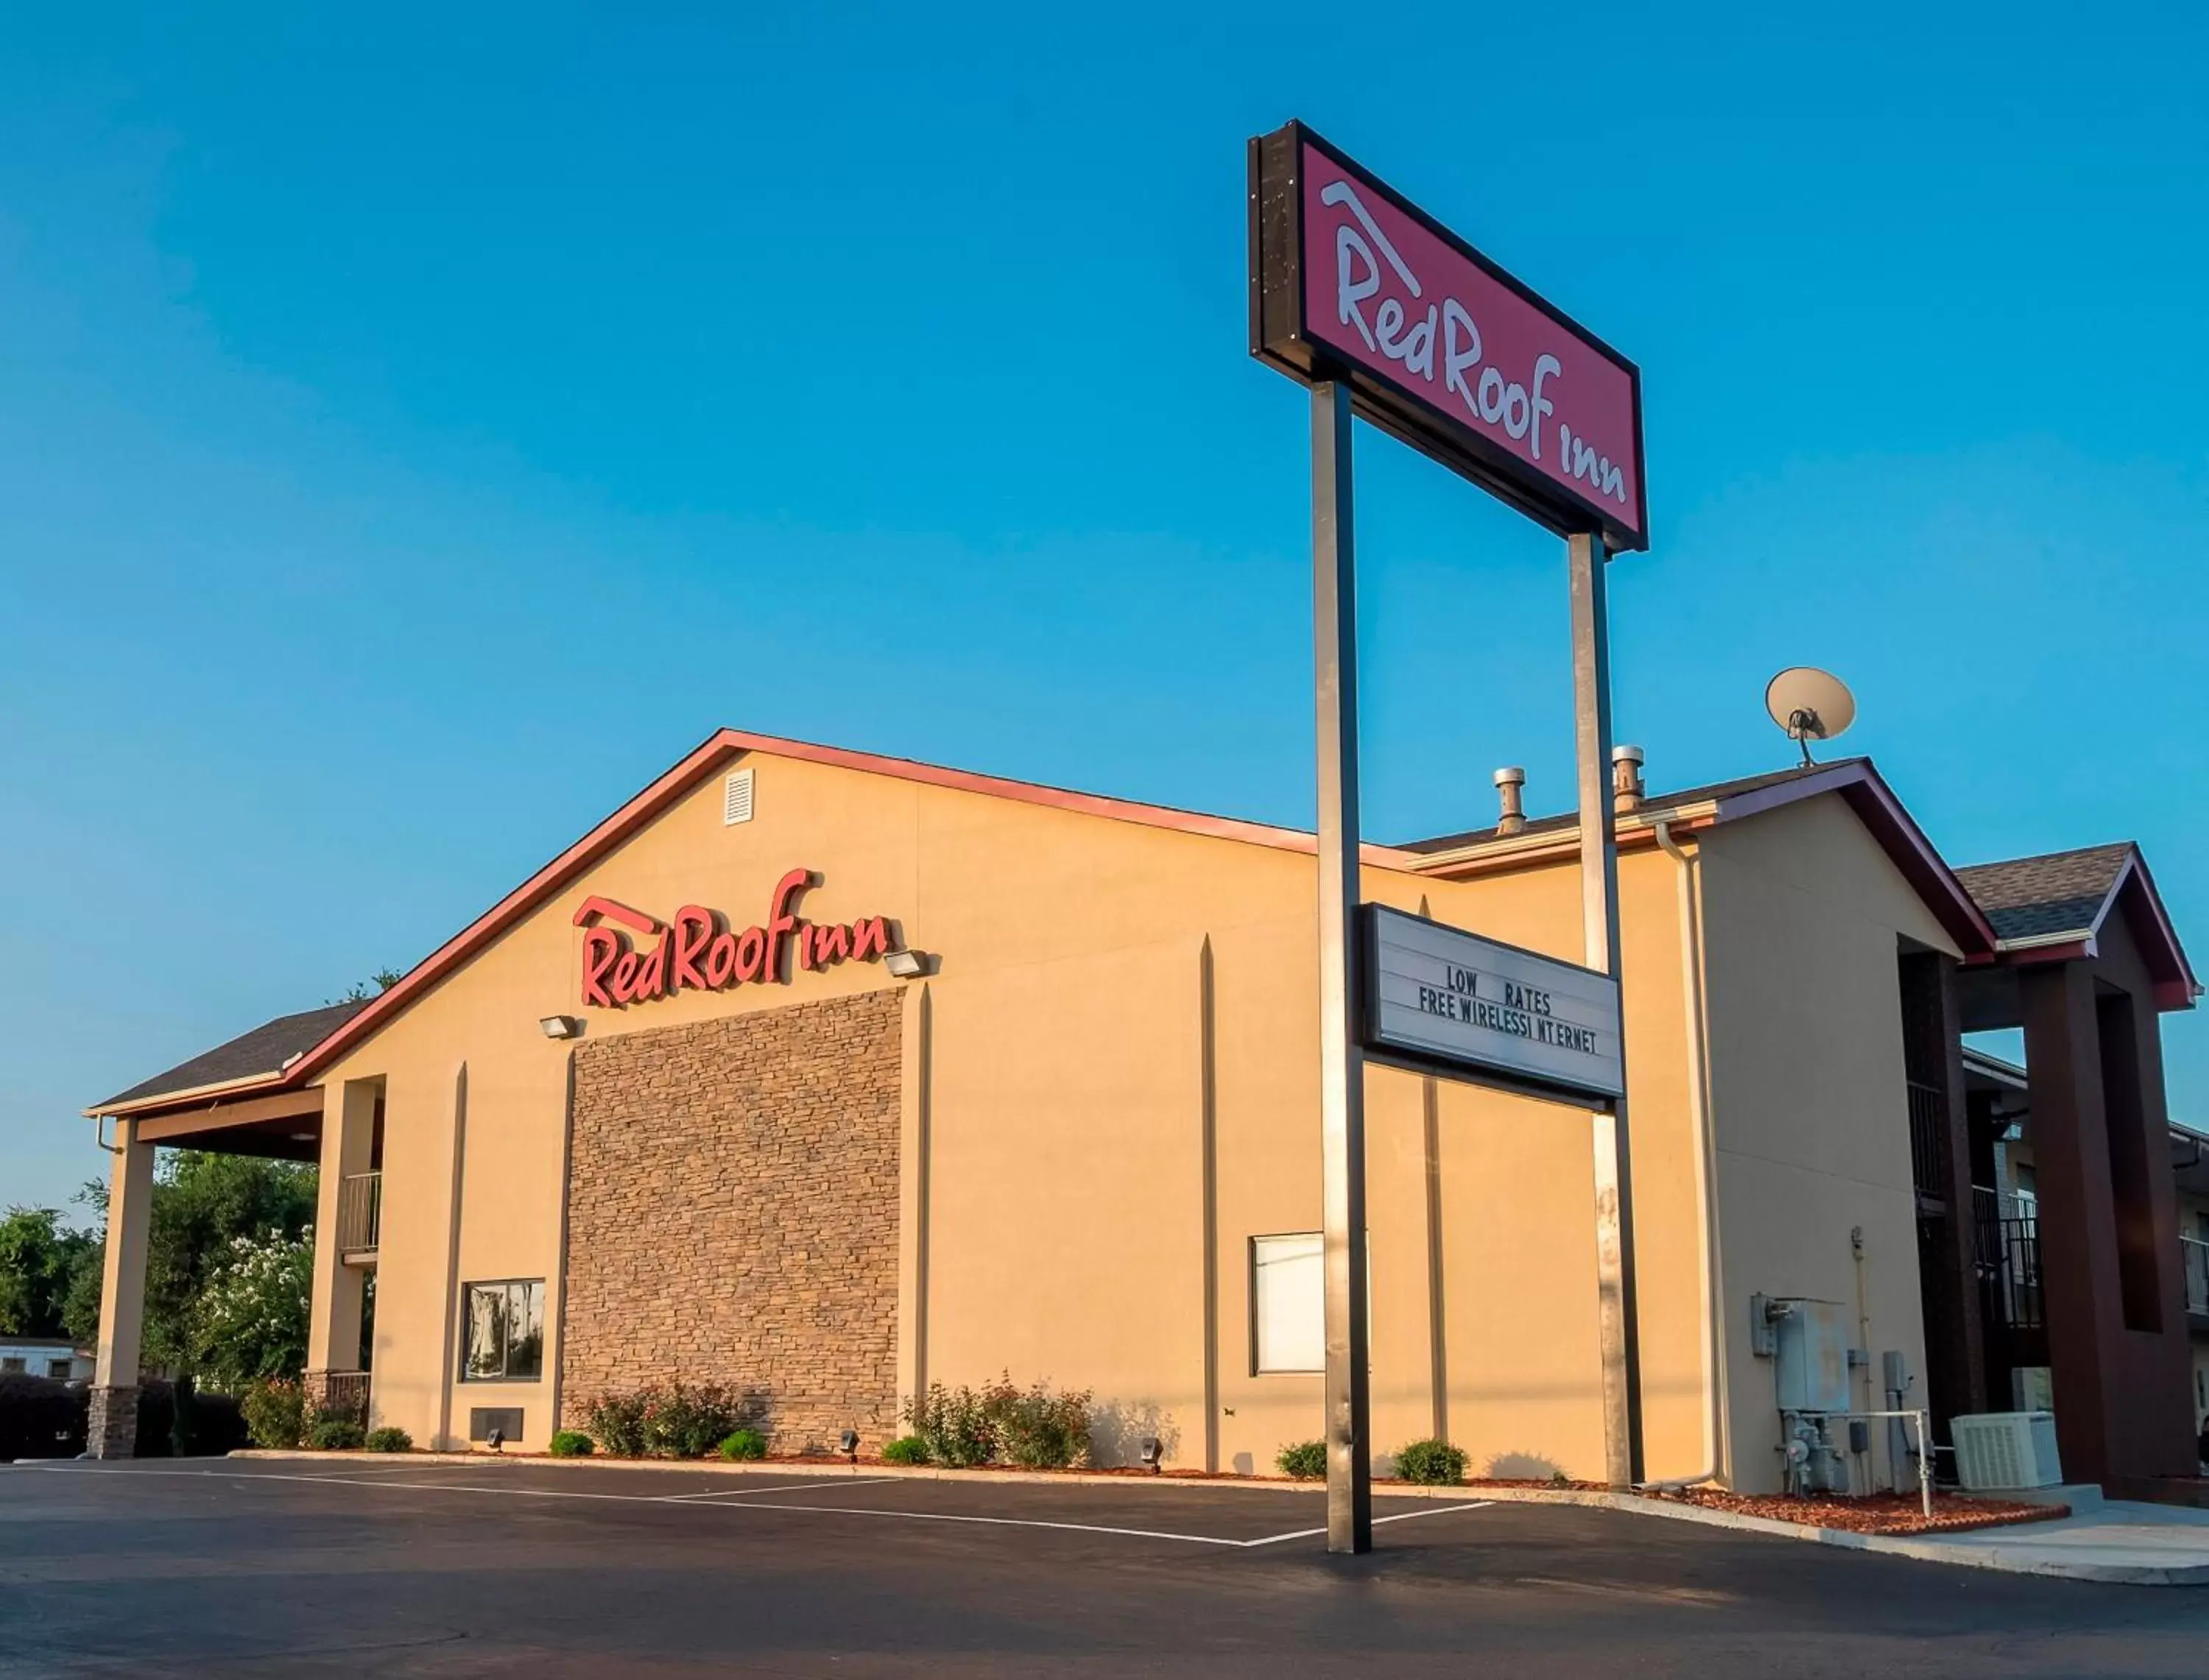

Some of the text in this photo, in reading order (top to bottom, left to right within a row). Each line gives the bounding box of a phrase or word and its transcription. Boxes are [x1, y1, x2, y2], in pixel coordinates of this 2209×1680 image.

[1419, 986, 1456, 1020] FREE
[1447, 965, 1551, 1016] LOW RATES
